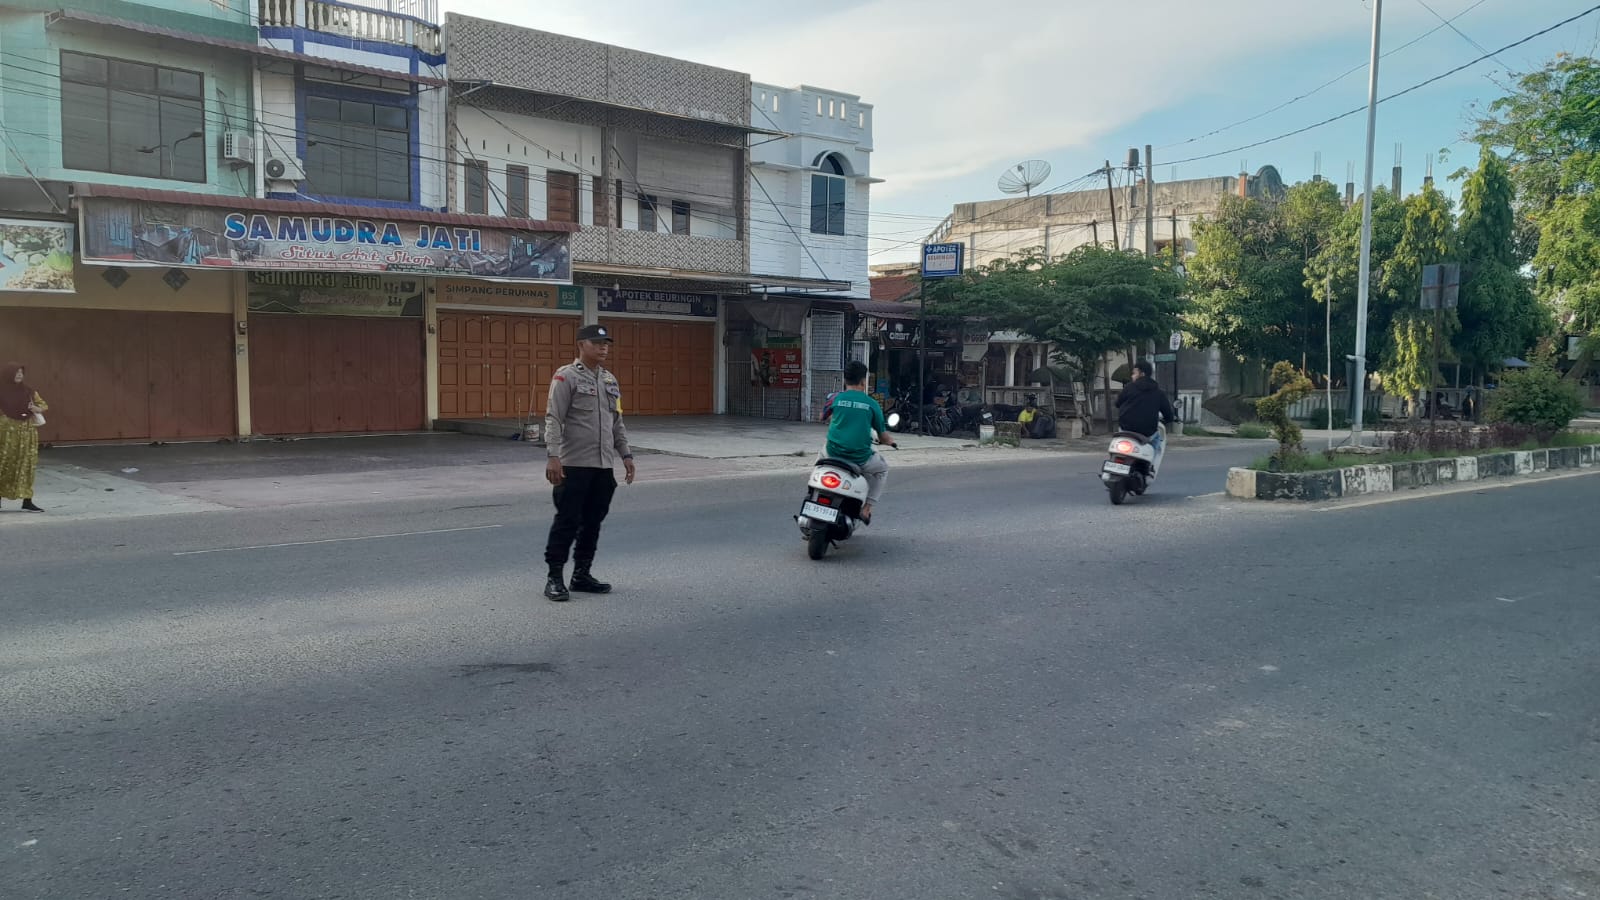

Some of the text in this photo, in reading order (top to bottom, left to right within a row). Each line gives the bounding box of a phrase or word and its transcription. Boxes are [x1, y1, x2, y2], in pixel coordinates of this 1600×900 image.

[224, 212, 481, 253] SAMUDRA JATI
[280, 245, 337, 260] Situs
[341, 247, 381, 263] Art
[385, 250, 435, 267] Shop
[445, 284, 550, 298] SIMPANG PERUMNAS
[615, 290, 702, 303] APOTEK BEURINGIN
